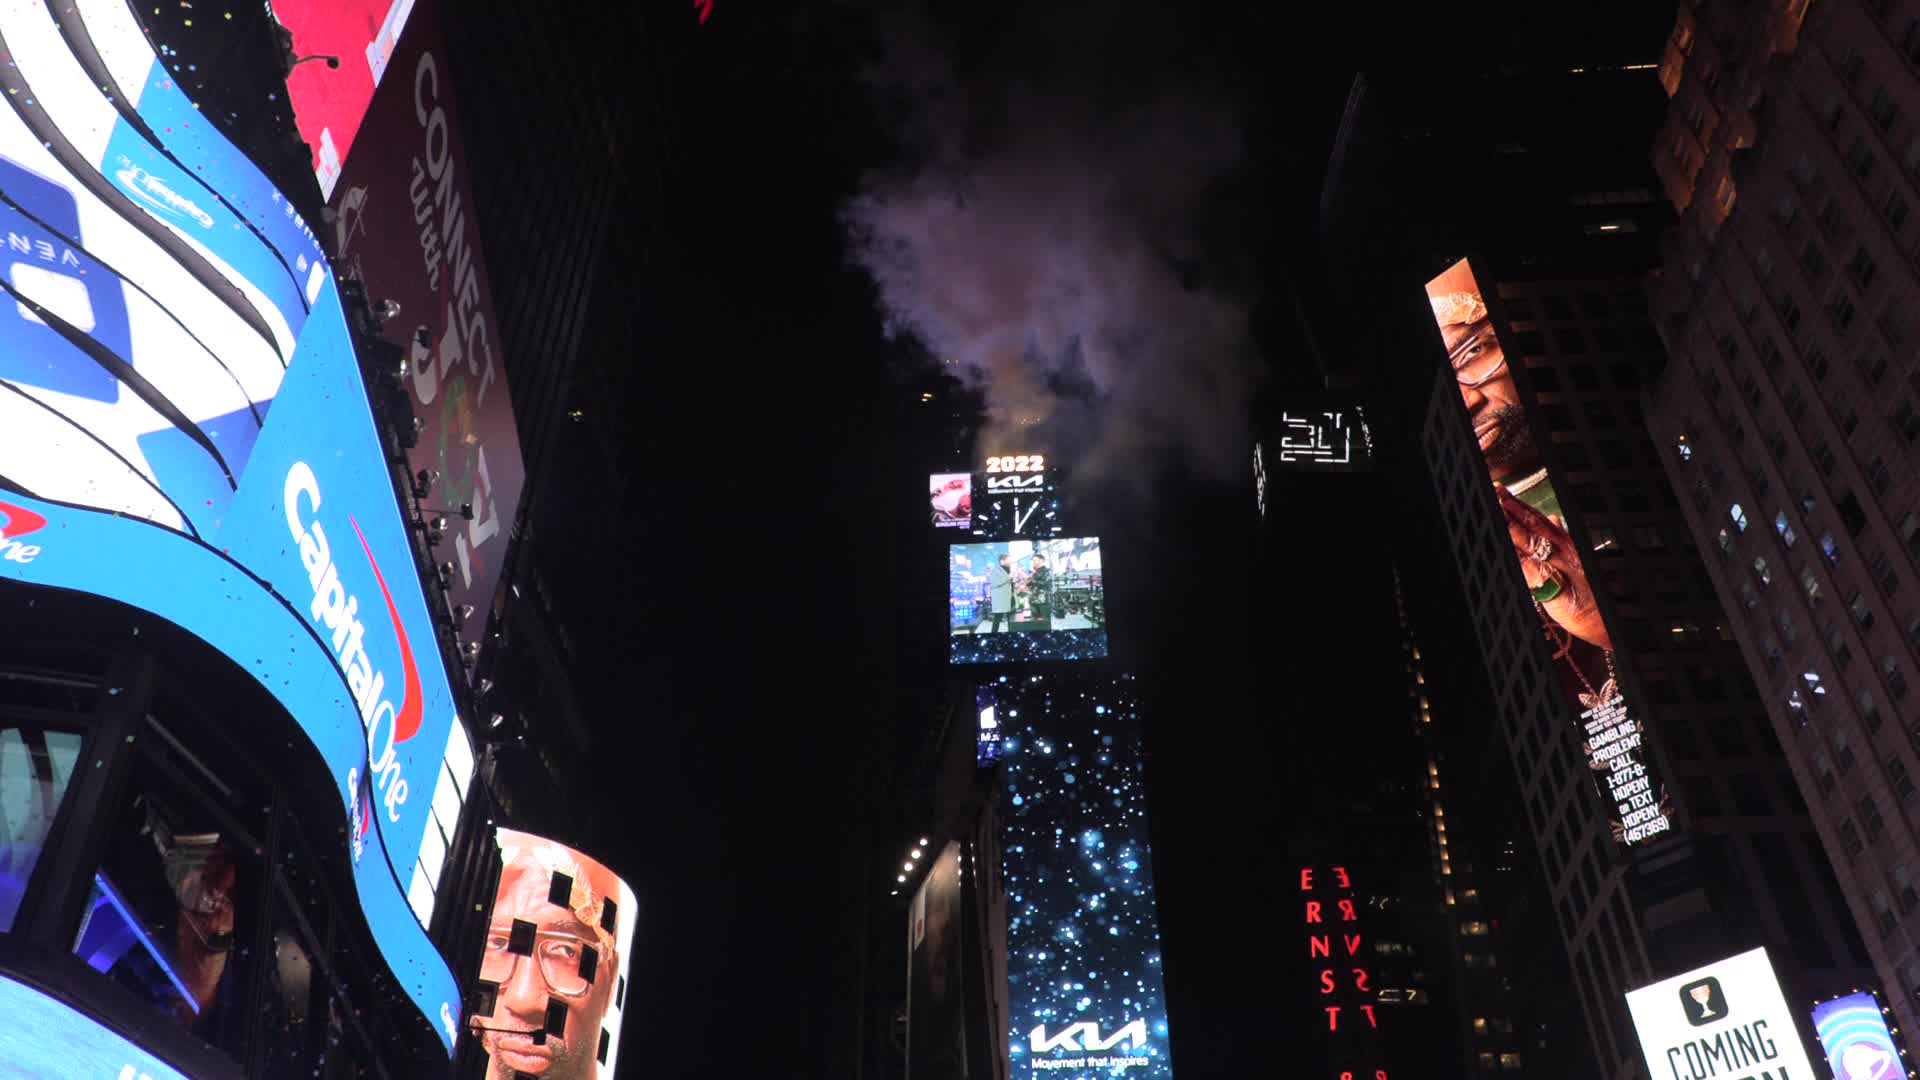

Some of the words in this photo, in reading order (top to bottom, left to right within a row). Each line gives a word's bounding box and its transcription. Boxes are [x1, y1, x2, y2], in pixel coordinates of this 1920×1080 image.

[414, 52, 495, 408] CONNECT
[986, 455, 1044, 473] 2022
[1588, 720, 1636, 750] GAMBLING
[1592, 733, 1641, 764] PROBLEM?
[1606, 763, 1646, 789] 1-877-8-
[1609, 753, 1636, 772] CALL
[1612, 775, 1649, 802] HOPENY
[1629, 789, 1653, 810] TEXT
[1621, 802, 1659, 829] HOPENY
[1623, 814, 1669, 846] (467369)
[1301, 868, 1341, 1031] ERNST
[1667, 1019, 1778, 1080] COMING
[1031, 1058, 1085, 1070] Movement
[1087, 1057, 1108, 1068] that
